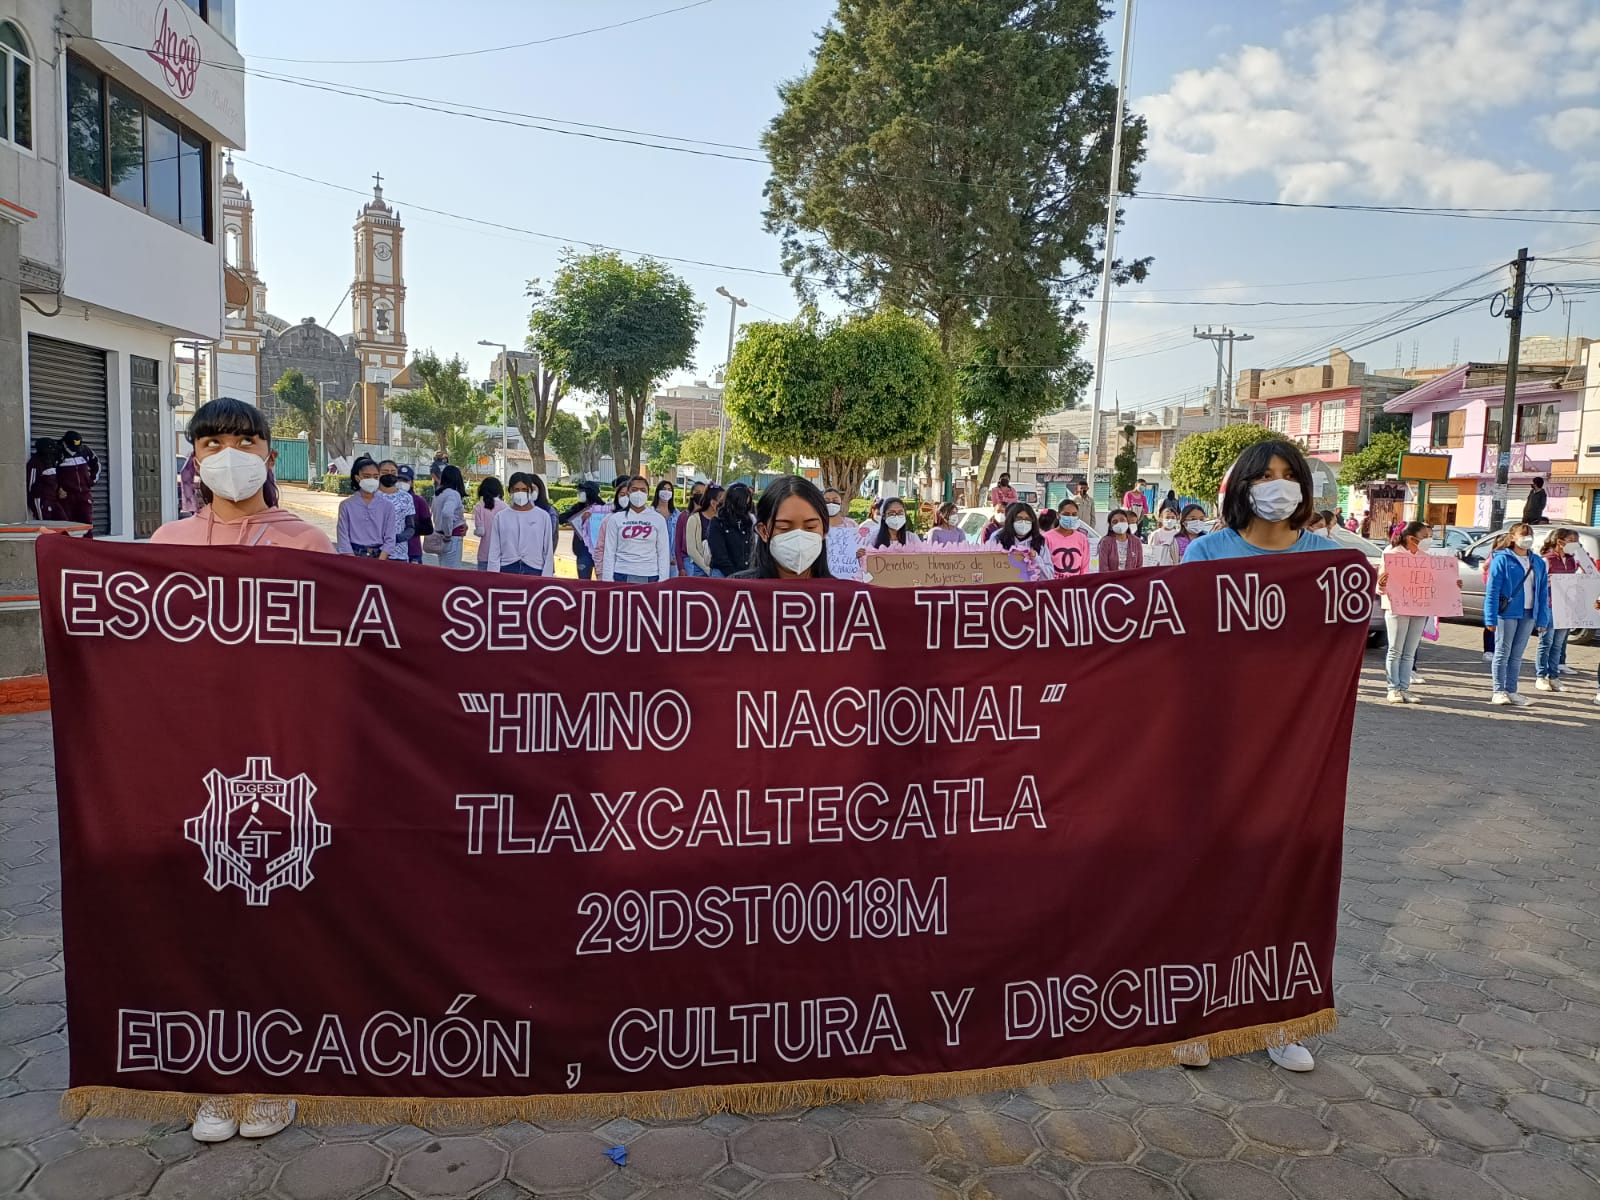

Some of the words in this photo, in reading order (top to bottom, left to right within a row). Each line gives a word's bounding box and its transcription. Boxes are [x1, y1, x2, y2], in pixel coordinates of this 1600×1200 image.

[621, 525, 653, 539] CD9
[874, 556, 920, 574] Derechos
[927, 556, 966, 570] Humanos
[970, 557, 983, 570] de
[992, 557, 1011, 569] las
[925, 572, 966, 585] Mujeres
[1394, 556, 1428, 569] FELIZ
[60, 568, 401, 649] ESCUELA
[440, 585, 886, 655] SECUNDARIA
[914, 578, 1186, 650] TECNICA
[1216, 573, 1286, 633] No
[1316, 562, 1373, 625] 18
[458, 689, 691, 753] "HIMNO
[736, 683, 1068, 749] NACIONAL"
[236, 783, 282, 794] DGEST
[455, 775, 1047, 855] TLAXCALTECATLA
[576, 876, 948, 955] 29DST0018M
[116, 993, 531, 1078] EDUCACIÓN
[608, 992, 907, 1073] CULTURA
[930, 987, 975, 1047] Y
[1004, 941, 1323, 1042] DISCIPLINA
